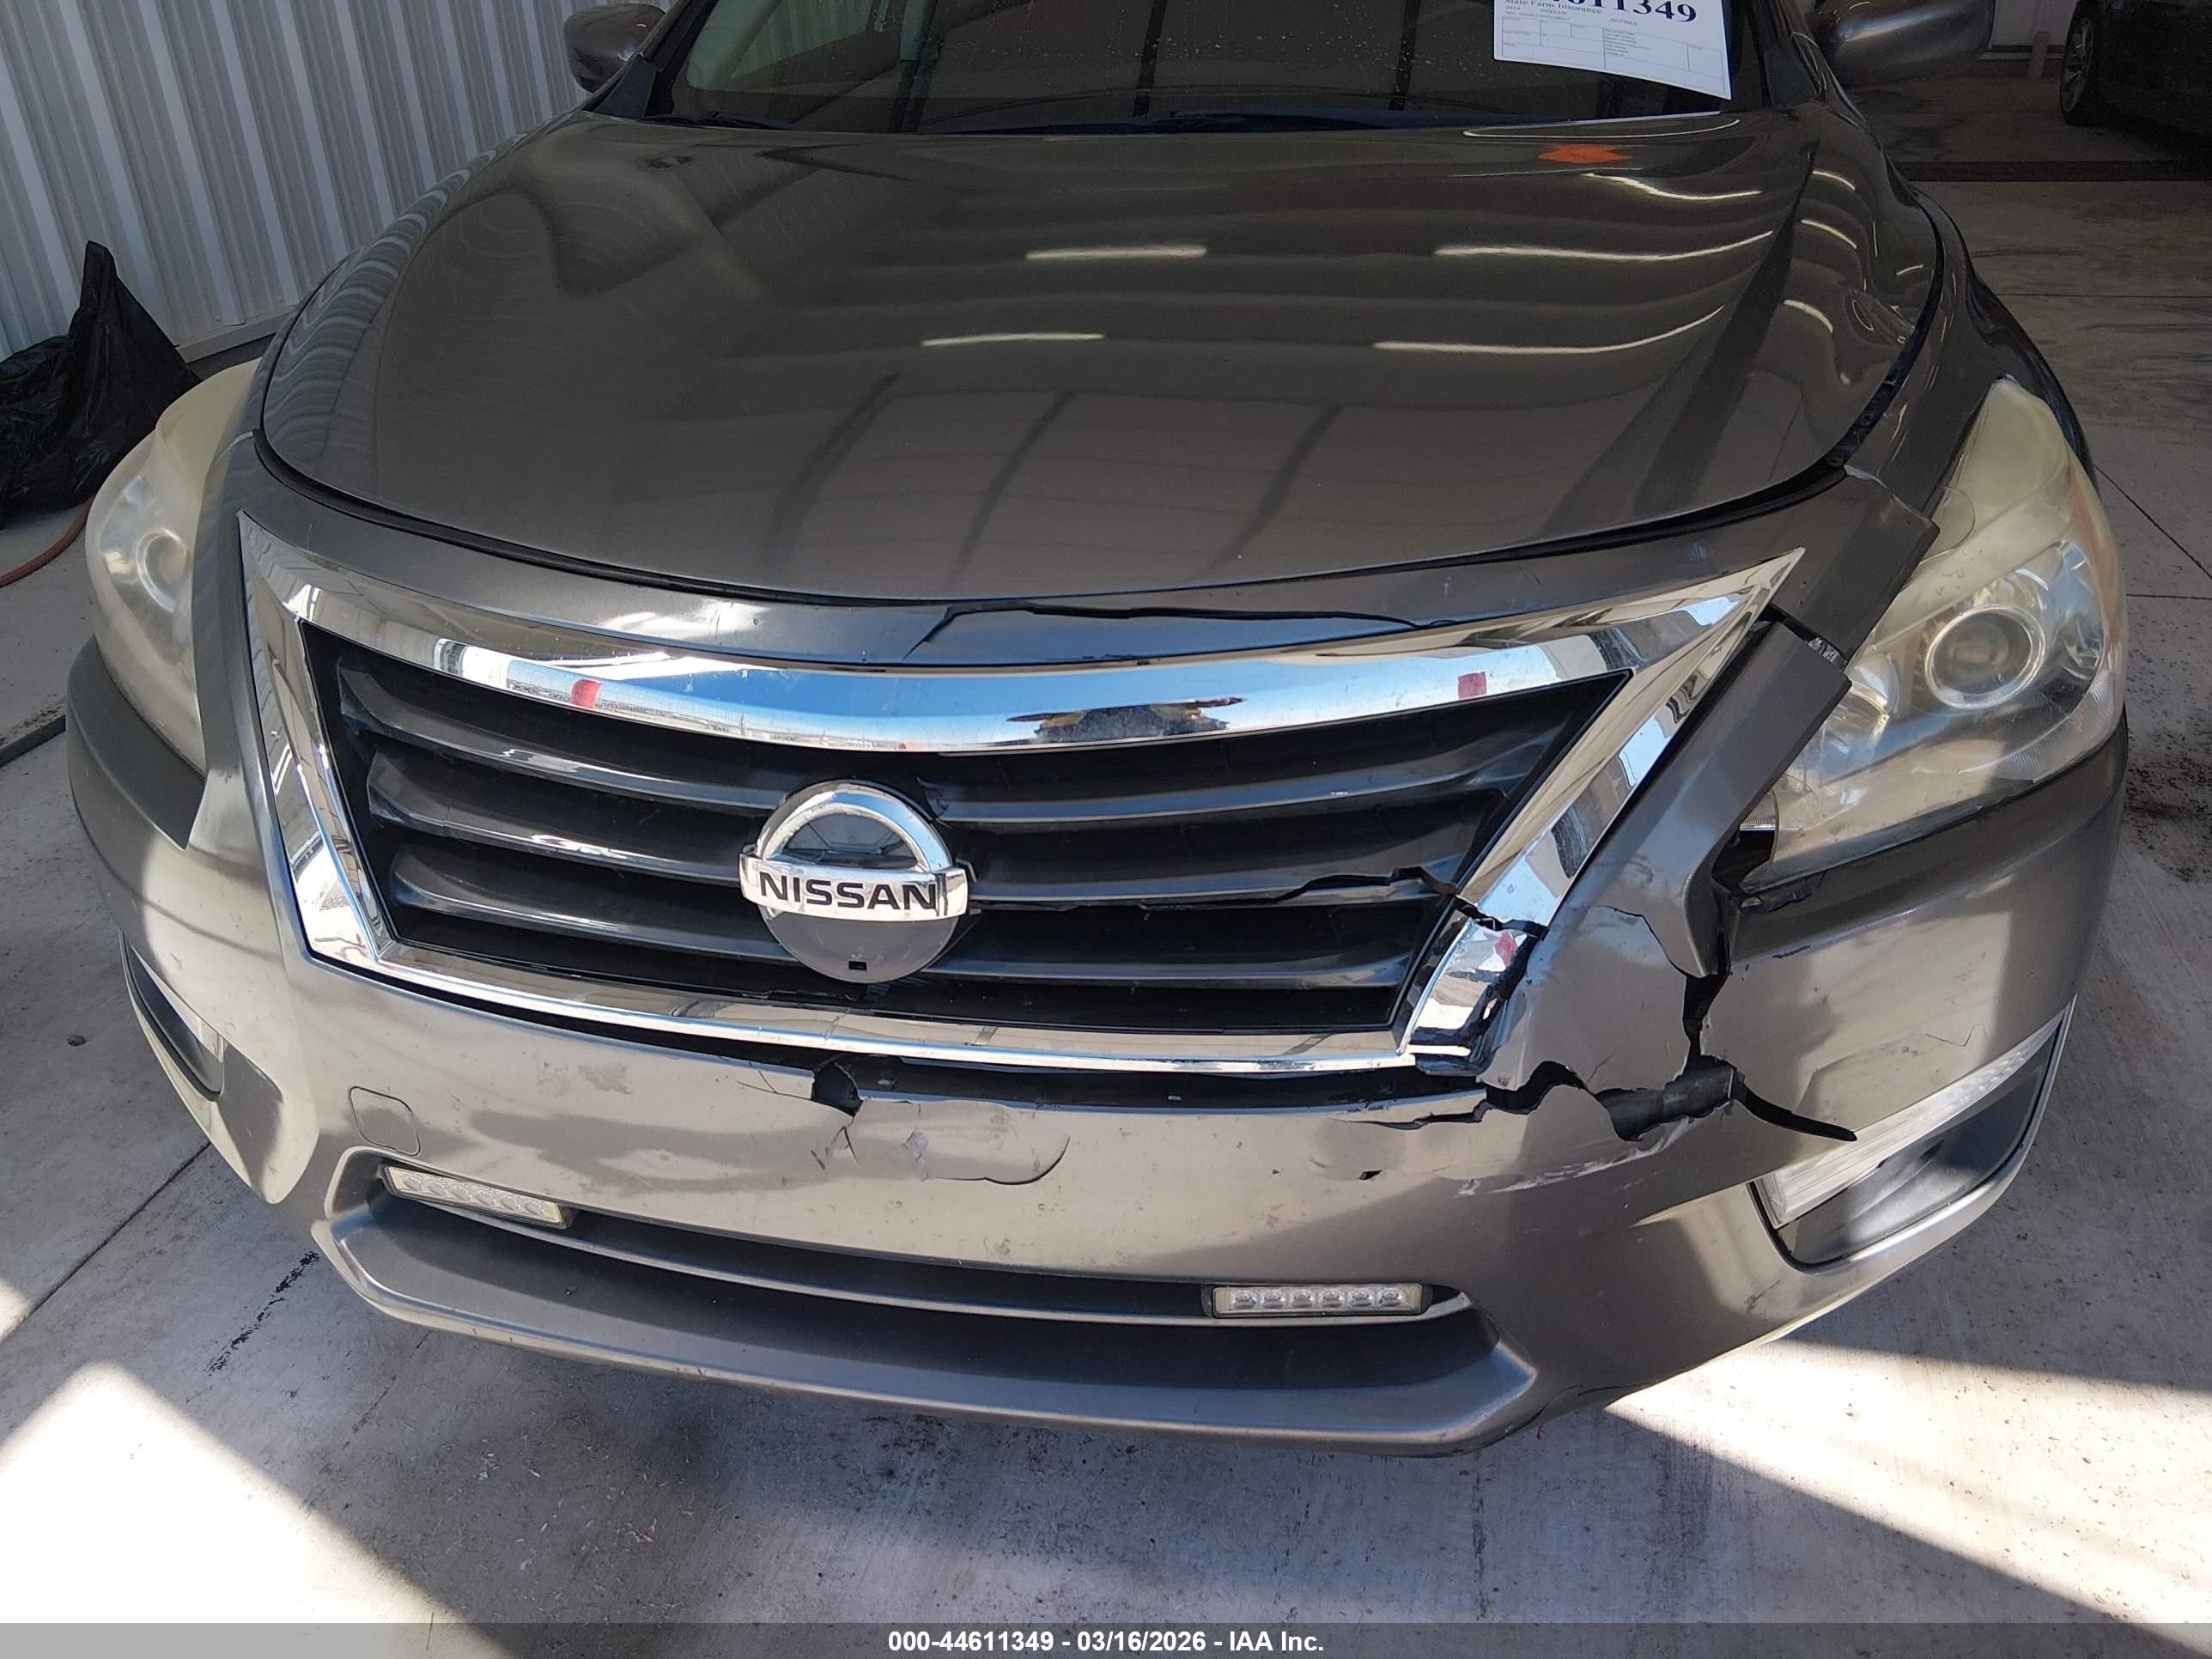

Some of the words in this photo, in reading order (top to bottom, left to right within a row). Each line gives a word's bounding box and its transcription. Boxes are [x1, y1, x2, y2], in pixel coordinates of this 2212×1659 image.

[1558, 3, 1602, 15] Insurance
[1609, 17, 1638, 27] ALTIMA
[758, 871, 937, 911] NISSAN
